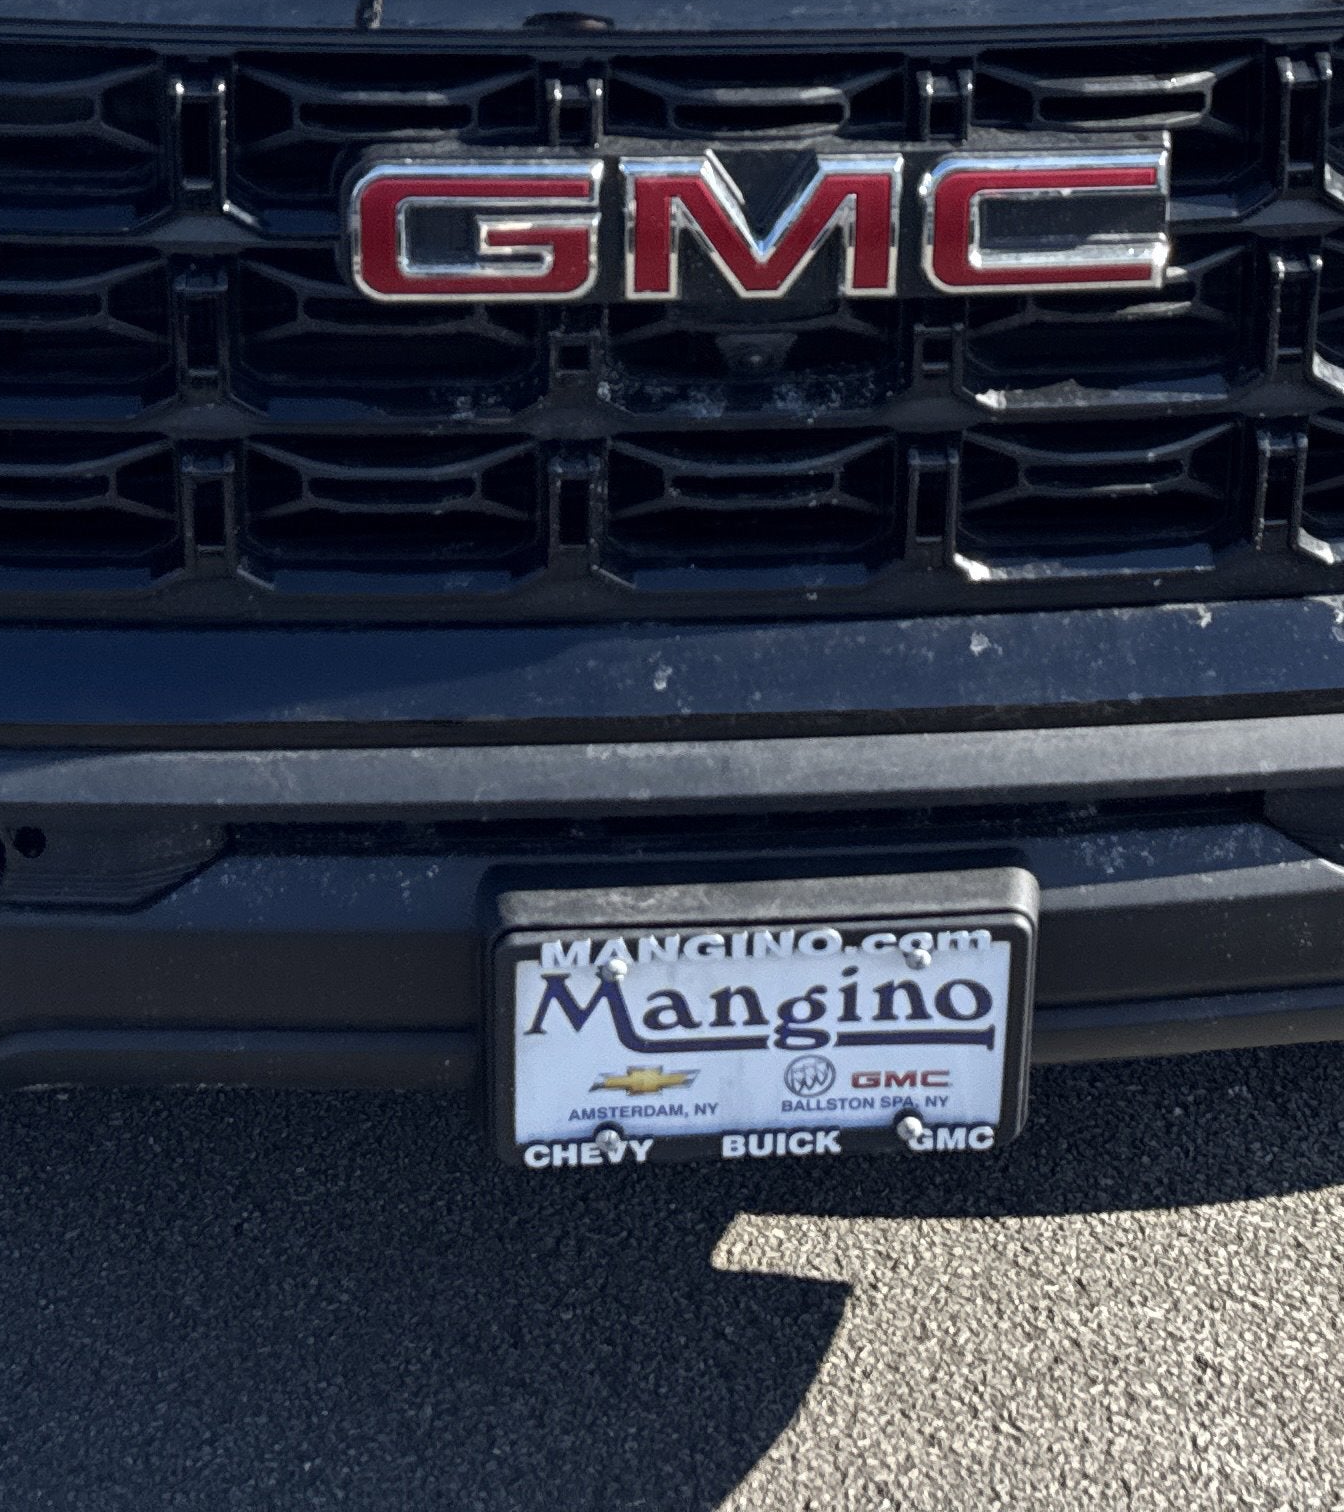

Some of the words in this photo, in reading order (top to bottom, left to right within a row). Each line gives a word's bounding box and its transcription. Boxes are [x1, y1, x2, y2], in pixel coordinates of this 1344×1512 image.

[350, 136, 1171, 301] GMC
[541, 929, 992, 968] MANGINO.com
[523, 965, 996, 1053] Mangino
[851, 1070, 950, 1089] GMC
[568, 1103, 689, 1121] AMSTERDAM,
[694, 1102, 719, 1116] NY
[781, 1096, 874, 1112] BALLSTON
[925, 1095, 949, 1108] NY
[524, 1138, 654, 1168] CHEVY
[722, 1129, 842, 1159] BUICK
[907, 1126, 995, 1152] GMC
